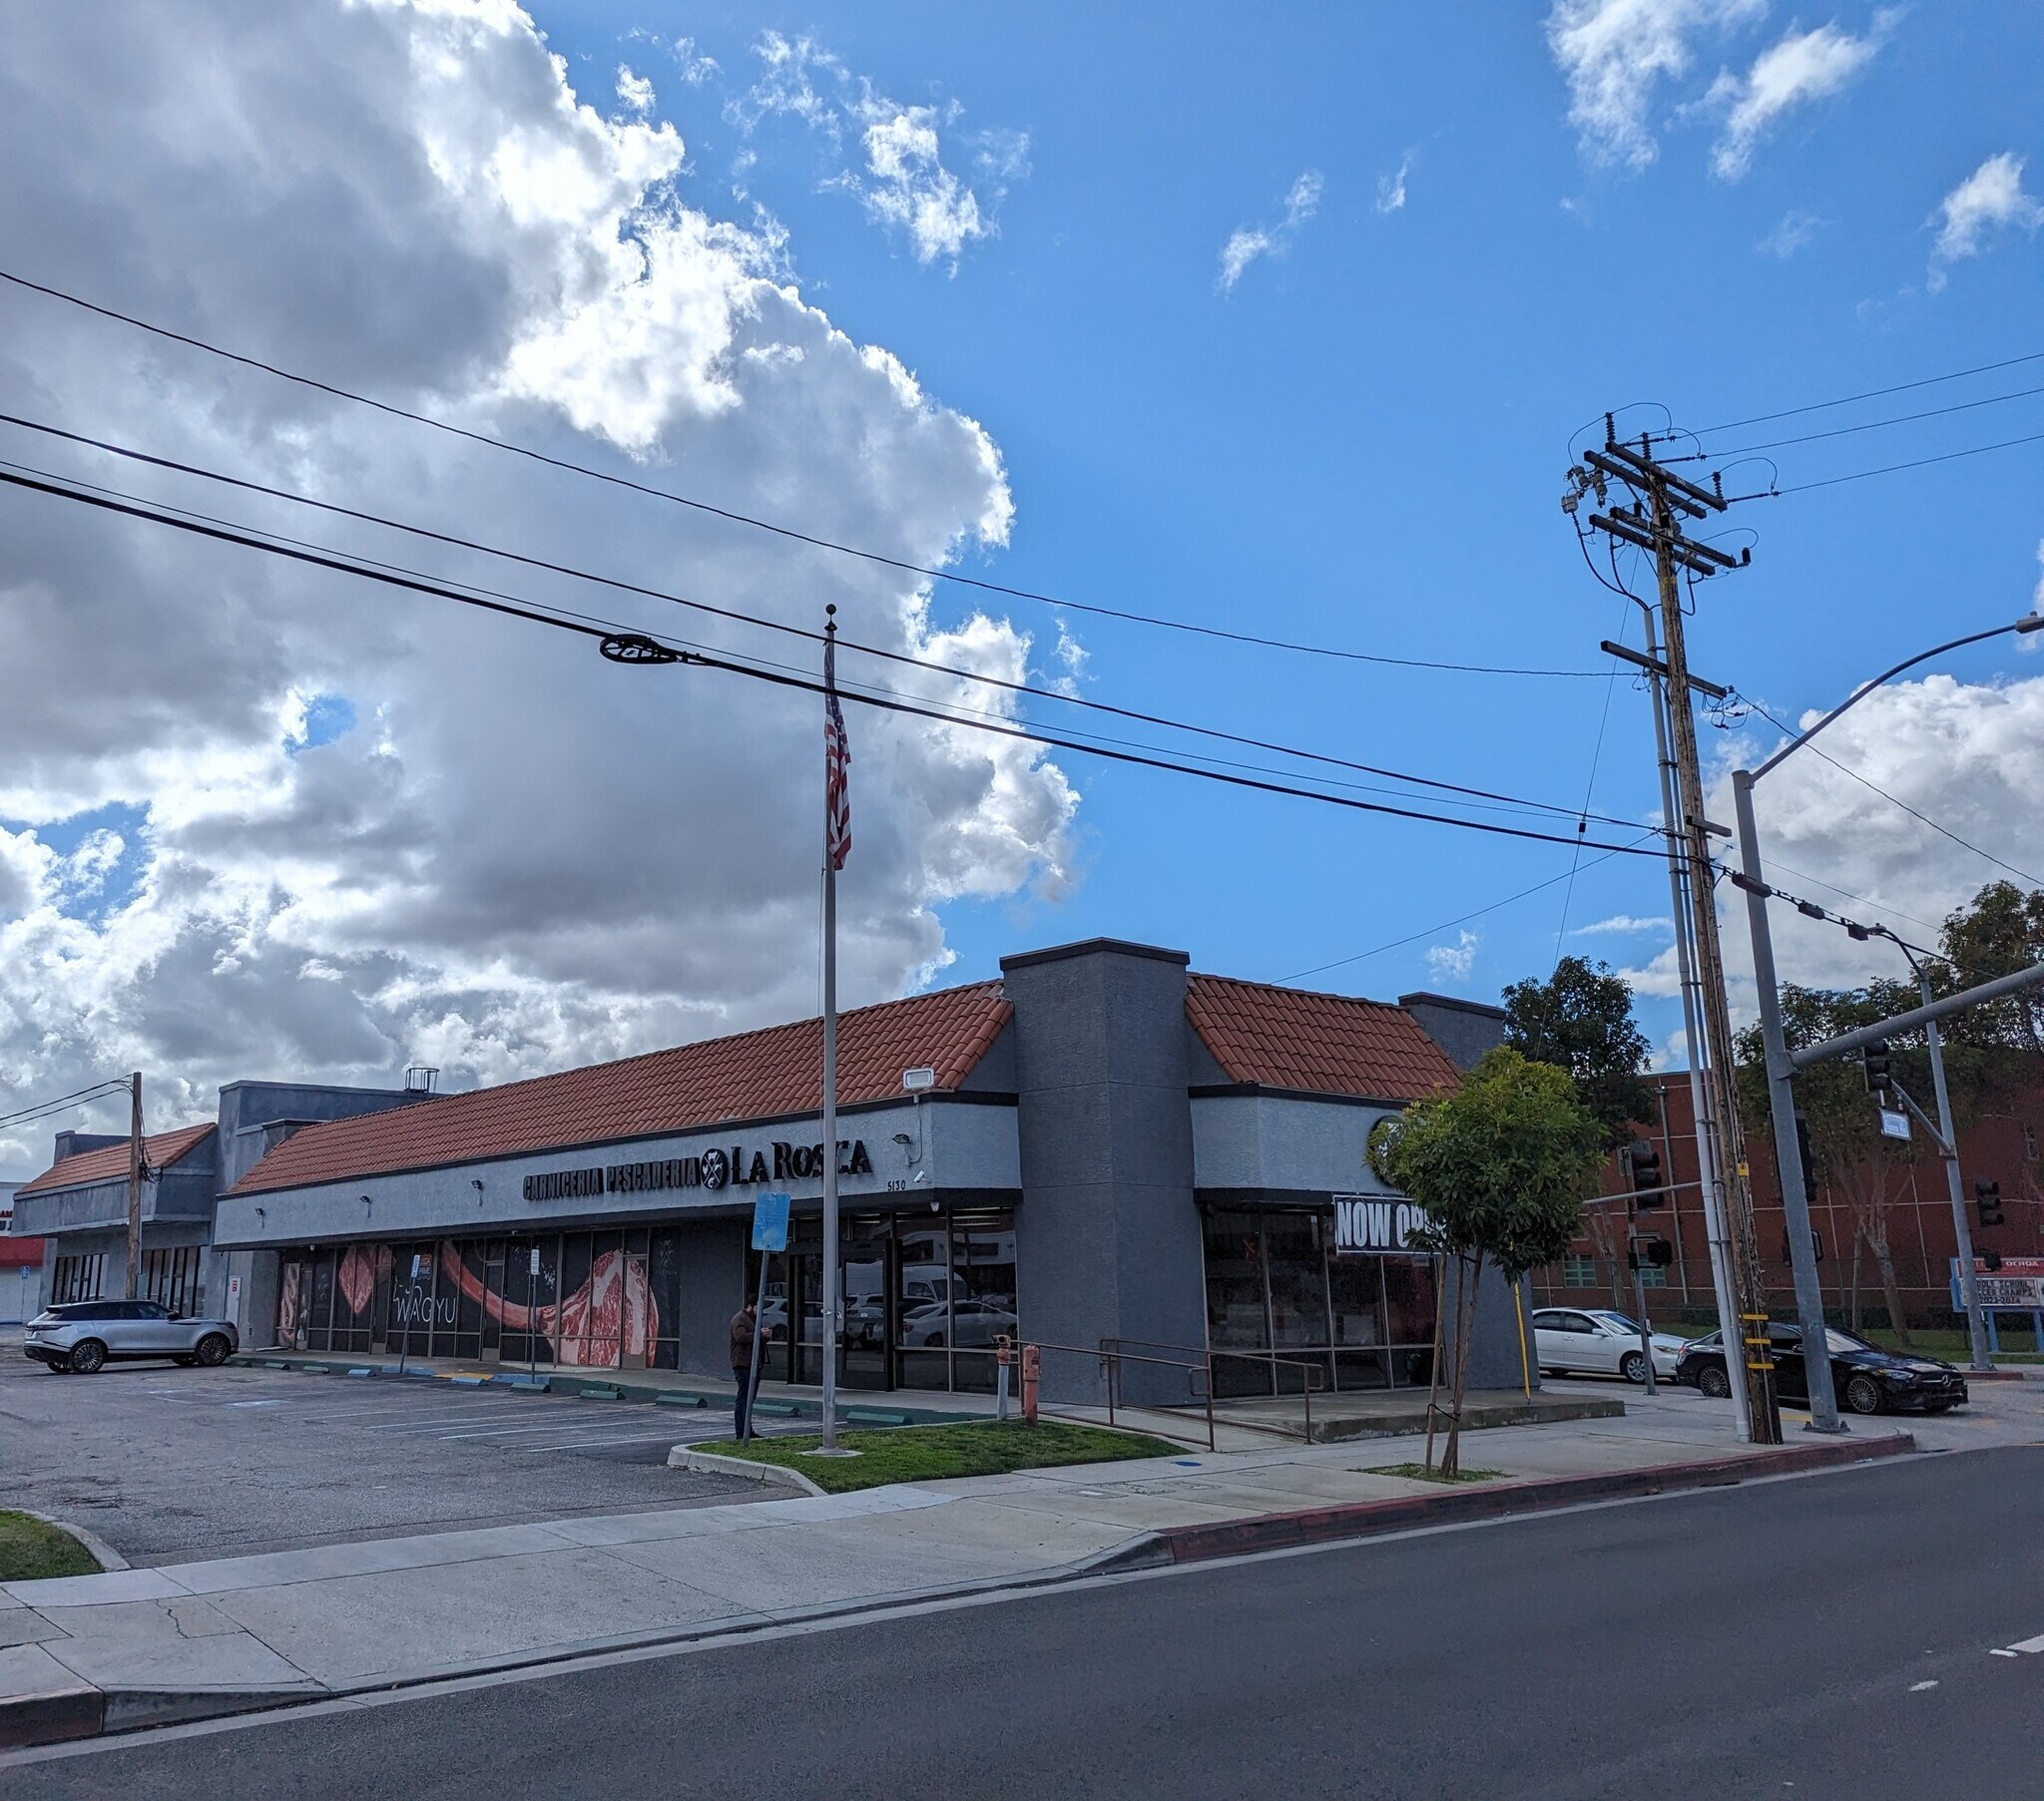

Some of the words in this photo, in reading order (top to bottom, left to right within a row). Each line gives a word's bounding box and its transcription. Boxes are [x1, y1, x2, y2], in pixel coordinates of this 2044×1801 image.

[523, 1167, 604, 1200] CARNICERIA
[607, 1157, 701, 1191] PESCADERIA
[887, 1179, 906, 1191] 5130
[1337, 1201, 1391, 1247] NOW
[2000, 1279, 2030, 1288] SCHOOL
[394, 1296, 456, 1323] WAGYU
